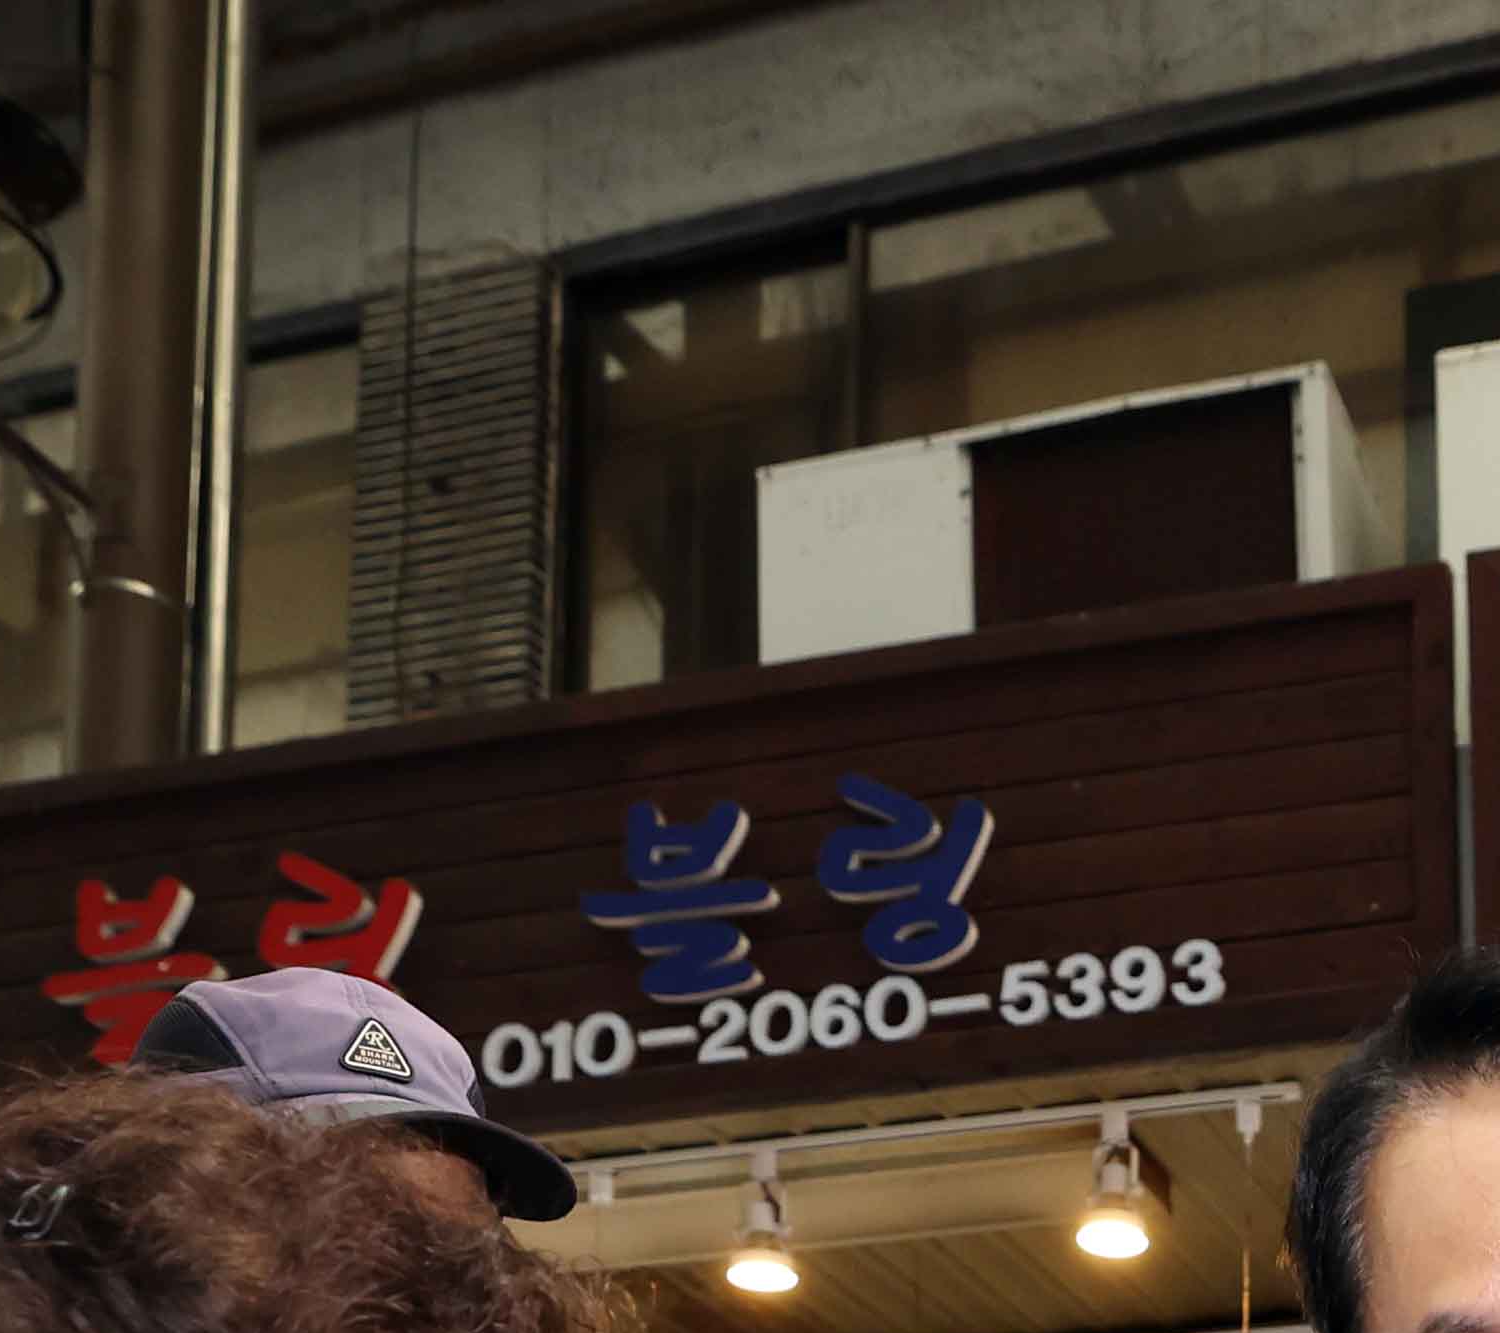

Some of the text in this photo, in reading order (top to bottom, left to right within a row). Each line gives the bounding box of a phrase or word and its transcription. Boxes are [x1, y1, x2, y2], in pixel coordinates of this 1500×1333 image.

[484, 937, 1226, 1089] 010-2060-5393
[354, 1055, 402, 1070] MOUNTAIN
[359, 1048, 395, 1062] SHARK
